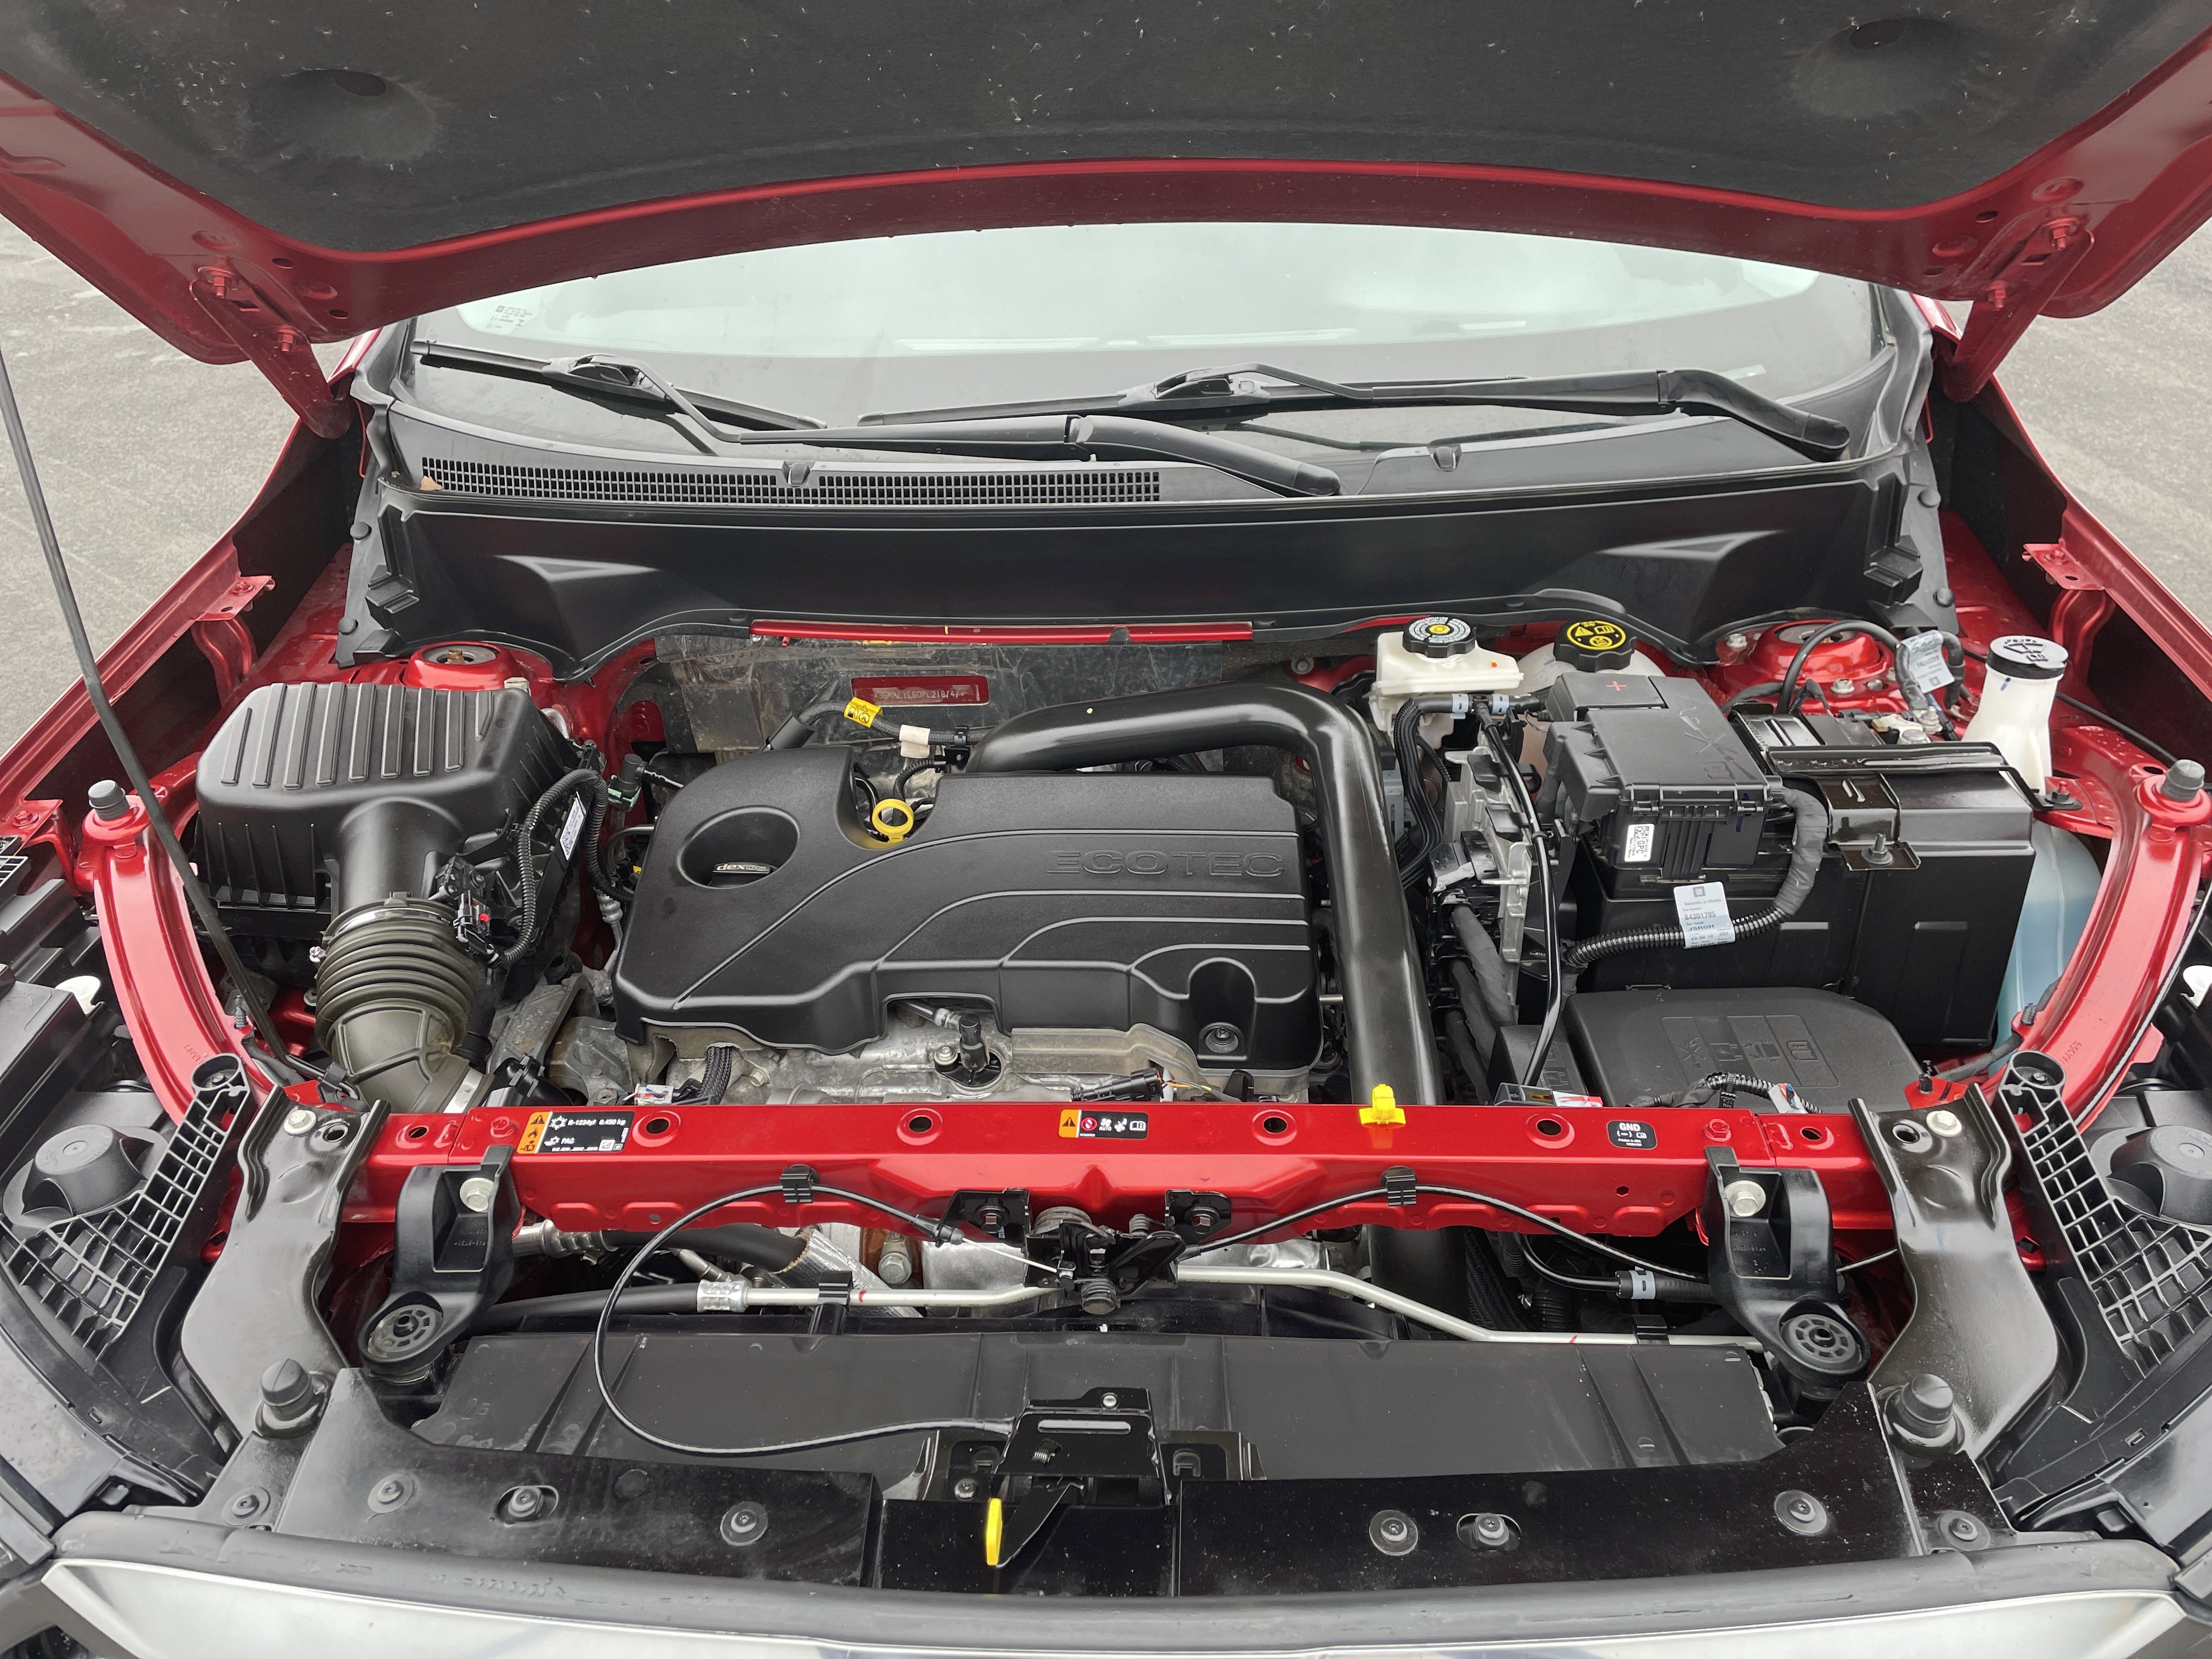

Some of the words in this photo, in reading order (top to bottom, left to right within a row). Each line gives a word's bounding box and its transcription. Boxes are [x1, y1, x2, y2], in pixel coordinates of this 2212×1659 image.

[1637, 840, 1645, 853] GPC
[1046, 850, 1285, 877] ECOTEC
[1685, 911, 1716, 920] 84301795
[1619, 1122, 1641, 1131] GND
